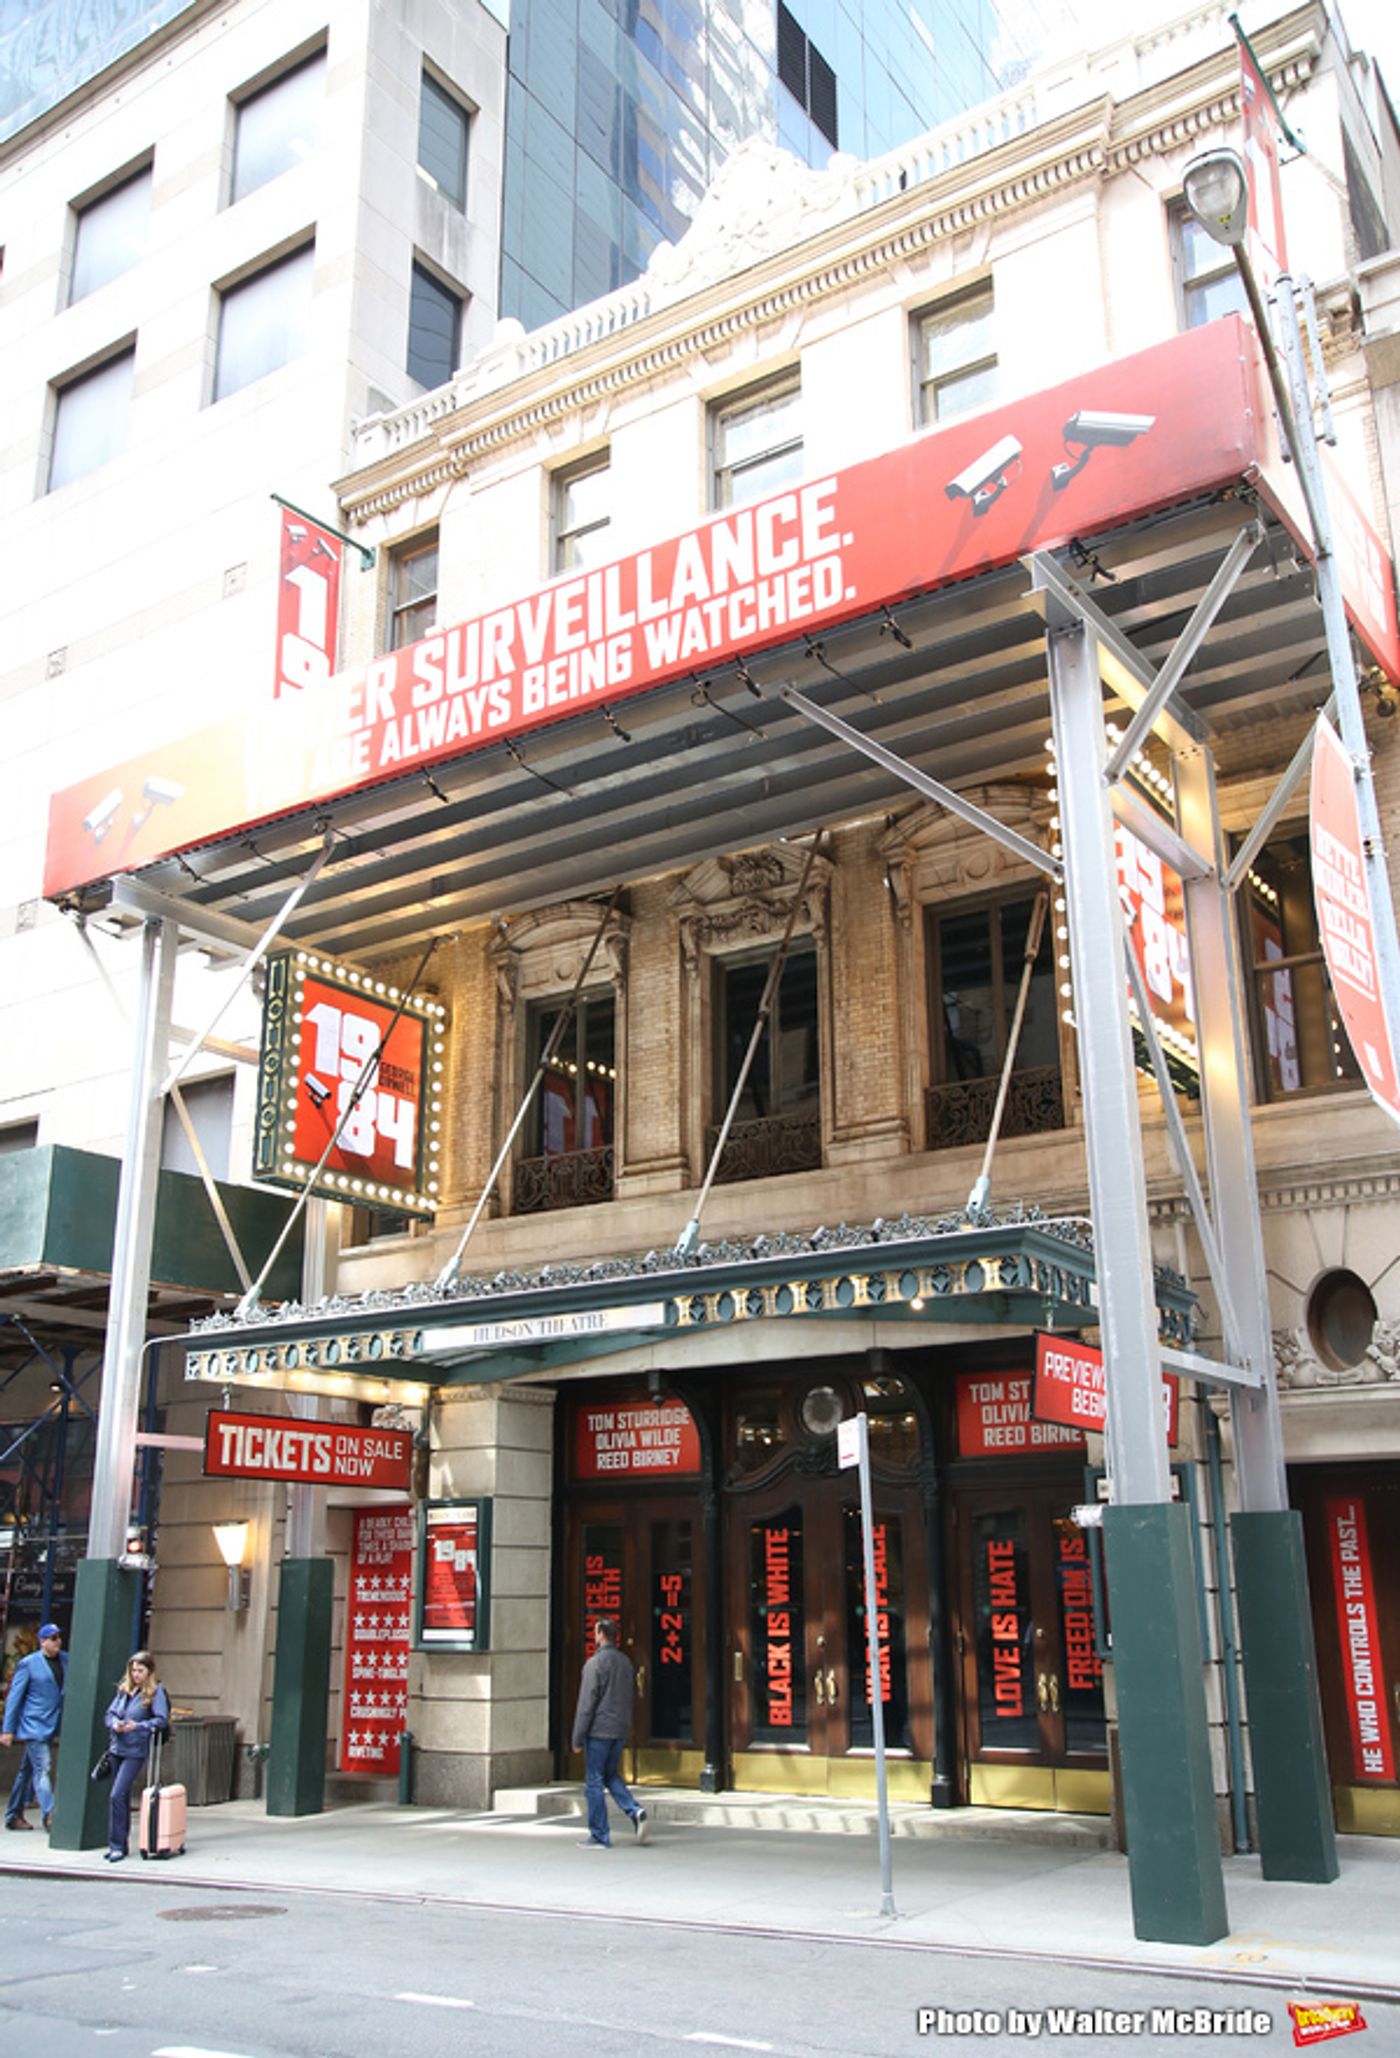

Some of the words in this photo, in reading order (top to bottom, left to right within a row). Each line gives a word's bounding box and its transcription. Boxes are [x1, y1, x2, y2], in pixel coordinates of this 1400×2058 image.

[411, 475, 854, 708] SURVEILLANCE.
[379, 679, 511, 767] ALWAYS
[522, 632, 633, 715] BEING
[643, 555, 857, 669] WATCHED.
[336, 1080, 416, 1170] 84
[473, 1321, 533, 1343] HUDSON
[538, 1313, 609, 1336] THEATRE
[969, 1382, 1004, 1404] TOM
[587, 1412, 614, 1431] TOM
[617, 1406, 689, 1429] STURRIDGE
[218, 1424, 333, 1473] TICKETS
[335, 1436, 359, 1455] ON
[363, 1439, 403, 1460] SALE
[595, 1430, 637, 1450] OLIVIA
[640, 1428, 681, 1446] WILDE
[984, 1425, 1025, 1447] REED
[334, 1456, 376, 1477] NOW
[597, 1451, 629, 1470] REED
[632, 1448, 680, 1468] BIRNEY
[1060, 1537, 1085, 1562] IS
[586, 1555, 603, 1575] IS
[765, 1528, 790, 1605] WHITE
[988, 1540, 1017, 1607] HATE
[1341, 1564, 1364, 1599] THE
[766, 1612, 791, 1637] IS
[991, 1613, 1020, 1640] IS
[1347, 1602, 1375, 1696] CONTROLS
[767, 1642, 793, 1726] BLACK
[994, 1647, 1023, 1717] LOVE
[1356, 1700, 1381, 1743] WHO
[1362, 1747, 1384, 1773] HE
